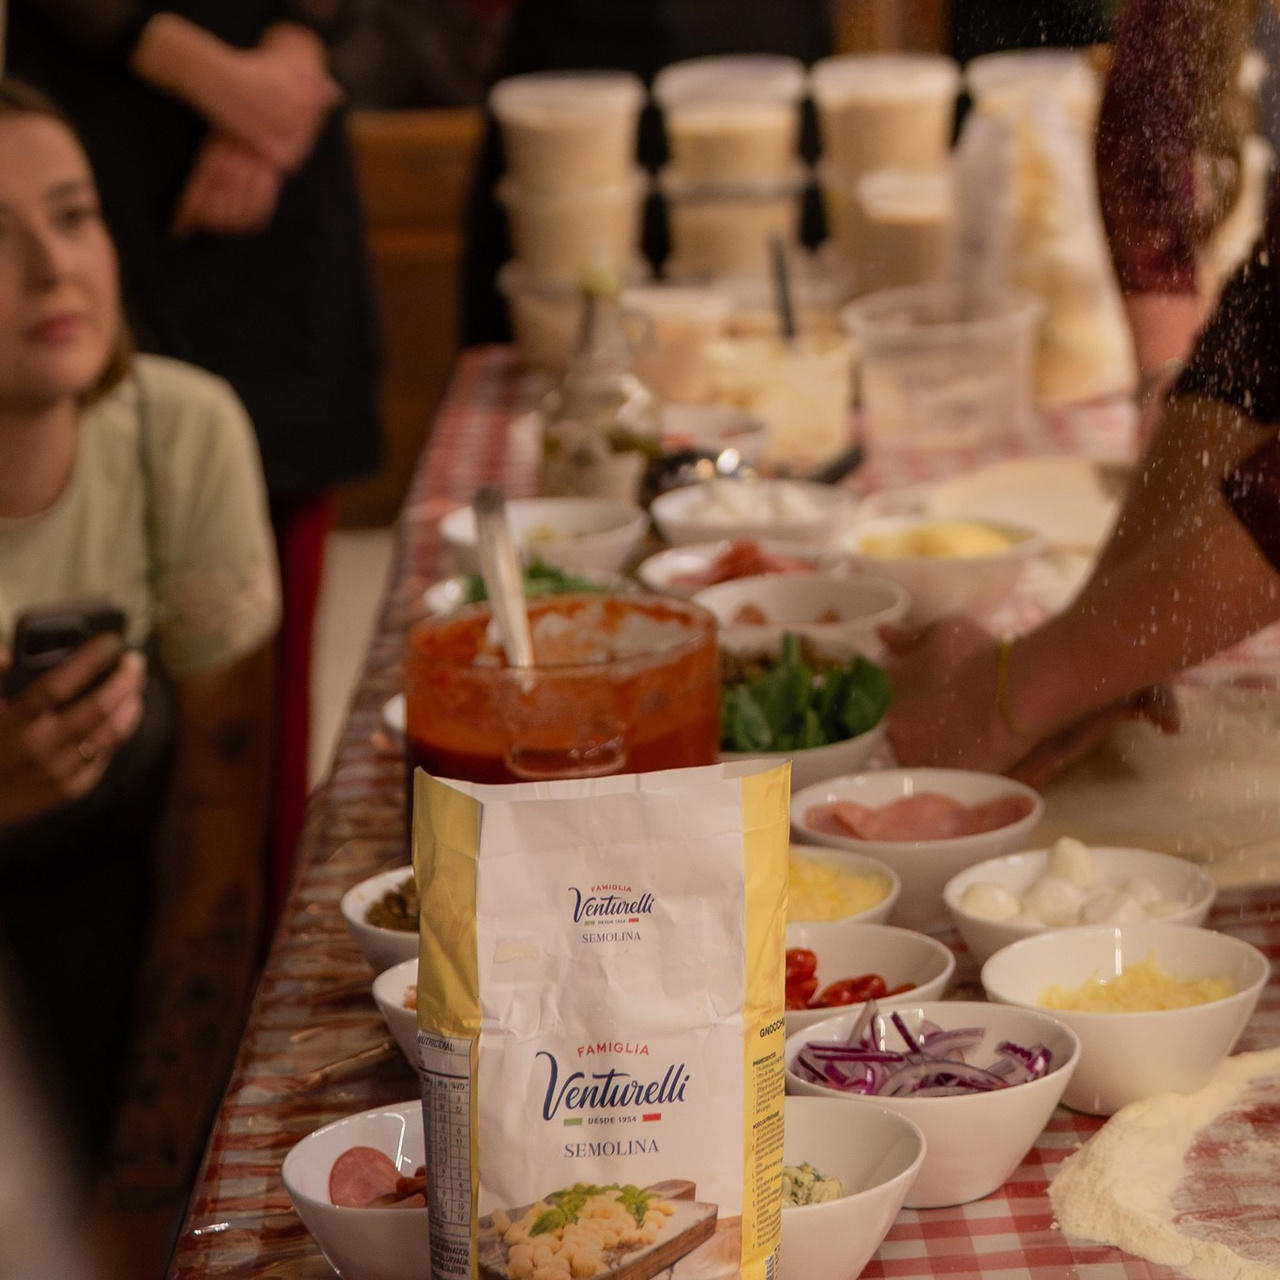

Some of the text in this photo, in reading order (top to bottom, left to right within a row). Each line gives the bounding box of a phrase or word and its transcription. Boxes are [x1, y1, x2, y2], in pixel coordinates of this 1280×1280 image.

[591, 884, 632, 893] FAMIGLIA
[567, 887, 655, 923] Venturelli
[582, 931, 641, 944] SEMOLINA
[577, 1042, 649, 1058] FAMIGLIA
[535, 1051, 690, 1121] Venturelli
[588, 1116, 614, 1125] DESDE
[564, 1139, 659, 1159] SEMOLINA
